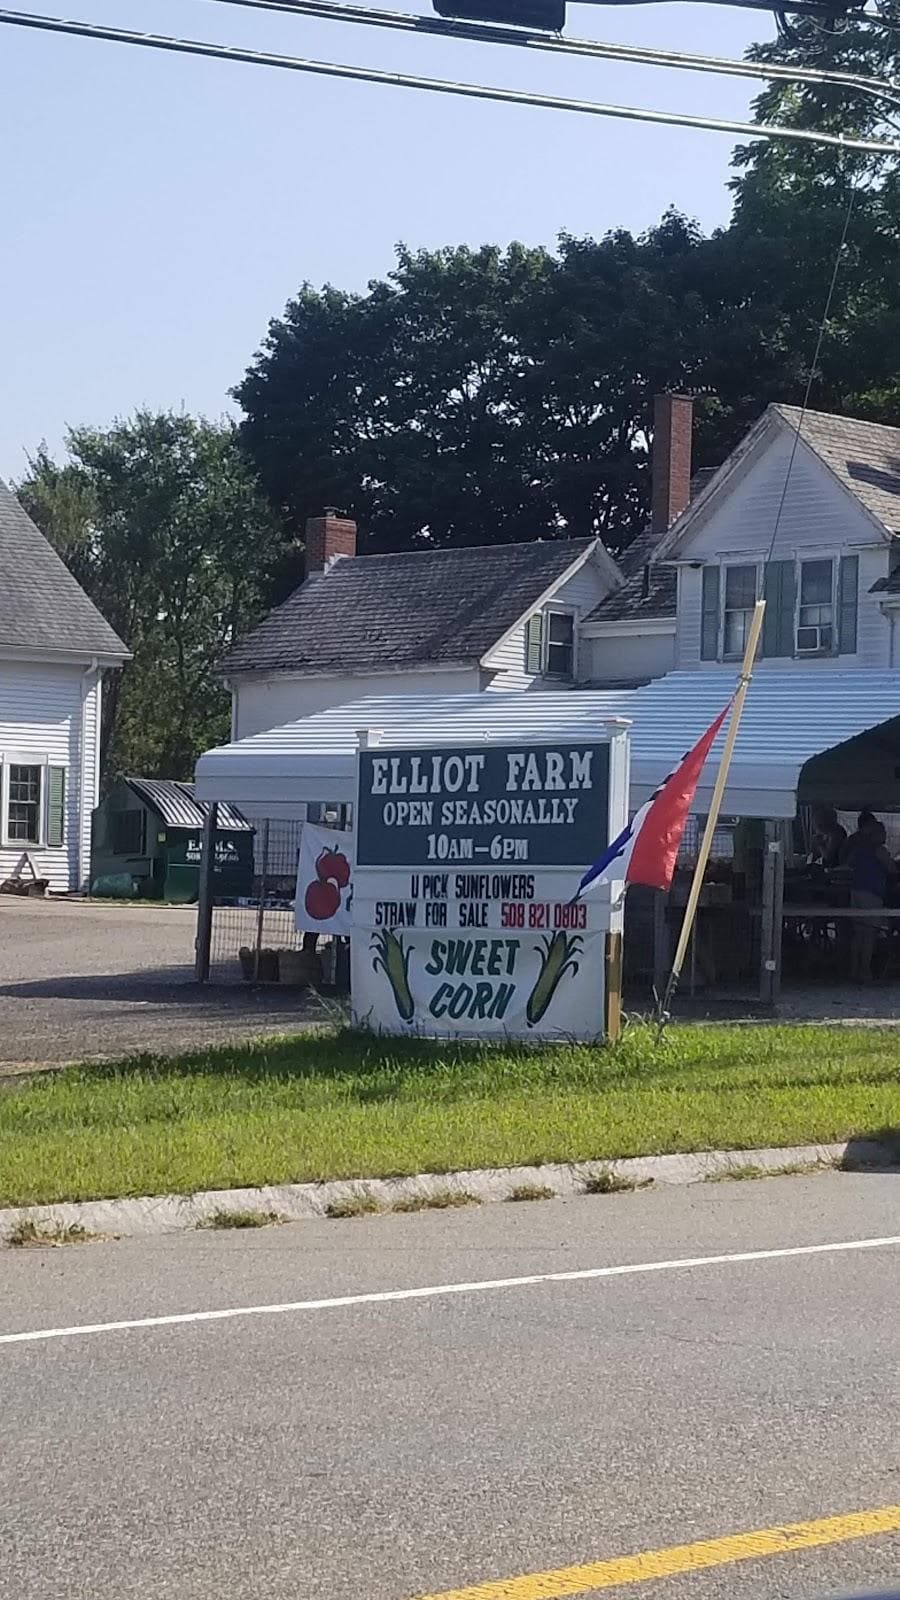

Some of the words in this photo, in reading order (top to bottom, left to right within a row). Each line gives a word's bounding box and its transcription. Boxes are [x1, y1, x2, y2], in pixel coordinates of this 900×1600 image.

[371, 754, 485, 794] ELLIOT
[505, 751, 594, 791] FARM
[383, 801, 434, 826] OPEN
[441, 798, 579, 825] SEASONALLY
[411, 874, 419, 899] U
[422, 874, 449, 899] PICK
[455, 874, 535, 899] SUNFLOWERS
[375, 902, 417, 927] STRAW
[425, 902, 447, 927] FOR
[459, 902, 489, 928] SALE
[501, 902, 525, 928] 508
[529, 903, 550, 928] 821
[554, 903, 587, 929] 0803
[424, 938, 521, 976] SWEET
[428, 981, 517, 1020] CORN
